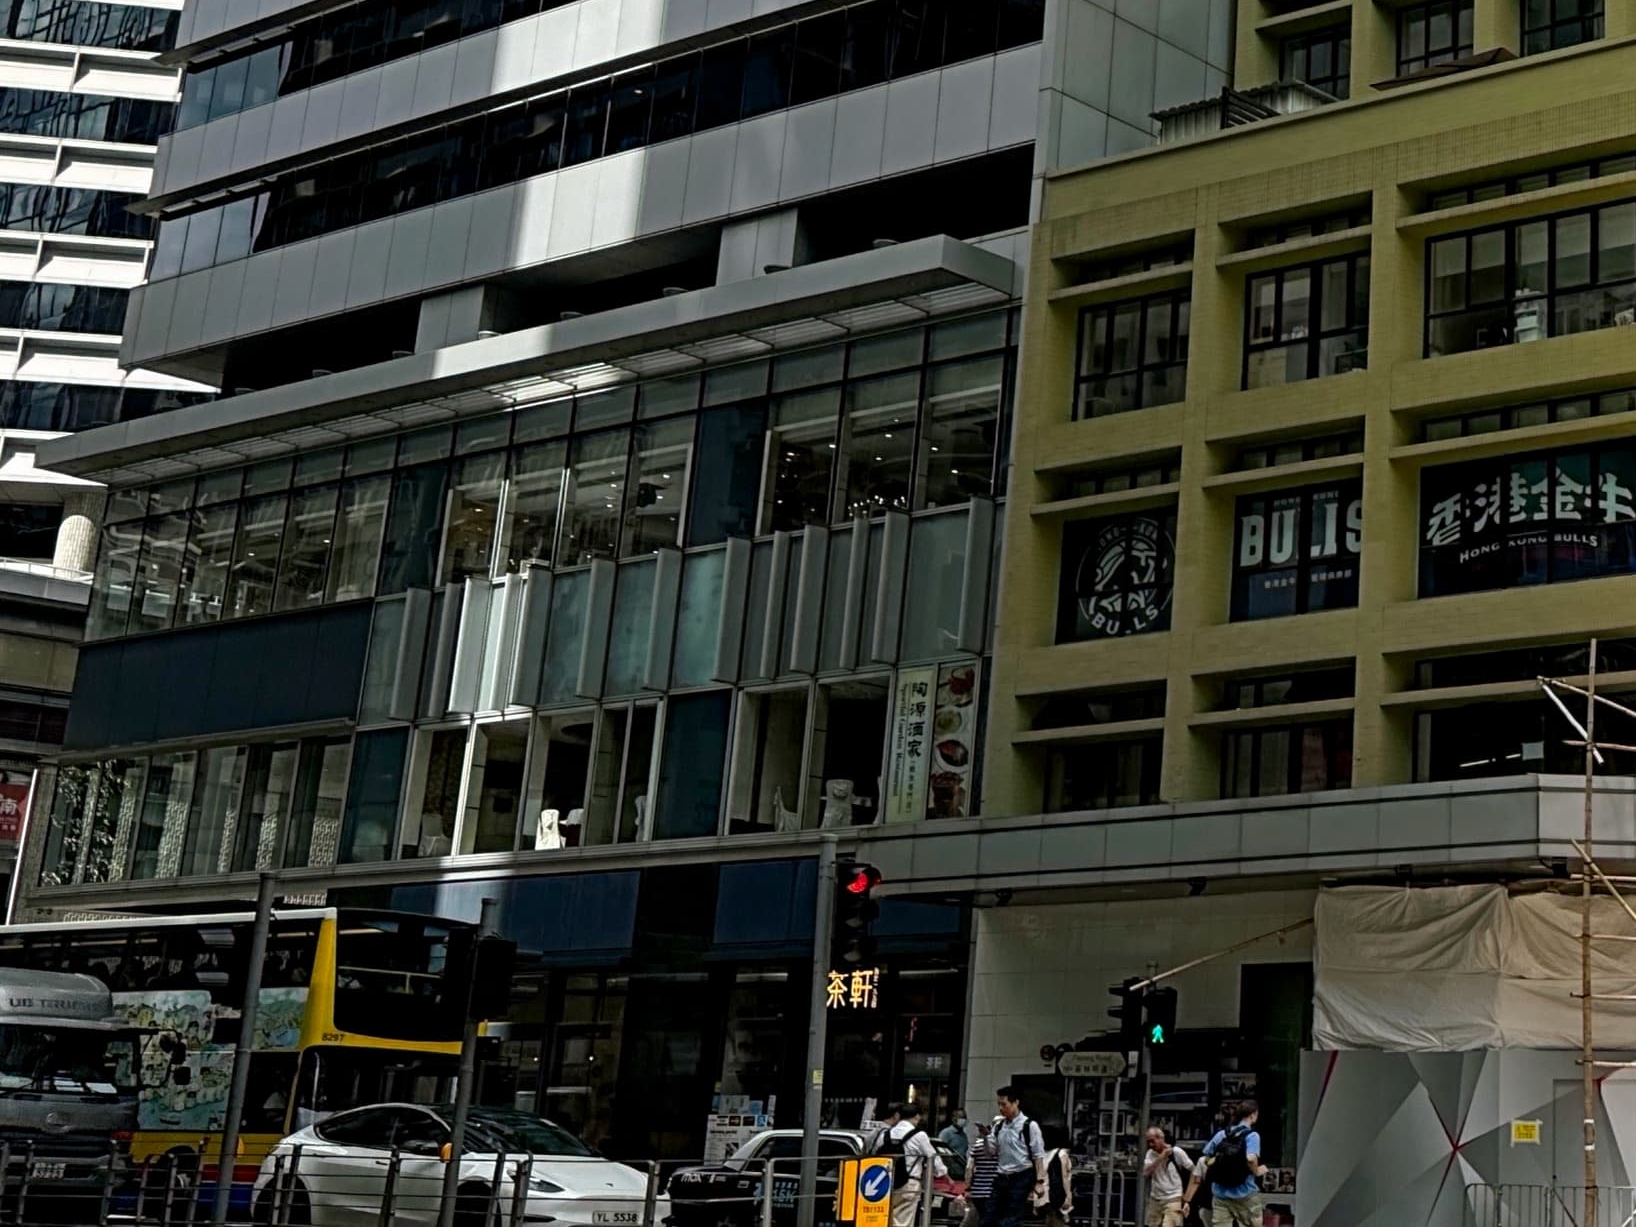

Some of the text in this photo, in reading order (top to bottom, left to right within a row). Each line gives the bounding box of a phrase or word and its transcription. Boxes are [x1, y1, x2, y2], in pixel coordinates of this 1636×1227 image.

[1426, 465, 1636, 547] 香港金牛
[1459, 542, 1500, 564] HONG
[1553, 532, 1598, 548] BULLS
[907, 682, 928, 758] 陶源酒家
[826, 969, 873, 1009] 茶軒
[597, 1212, 638, 1222] YL 5538
